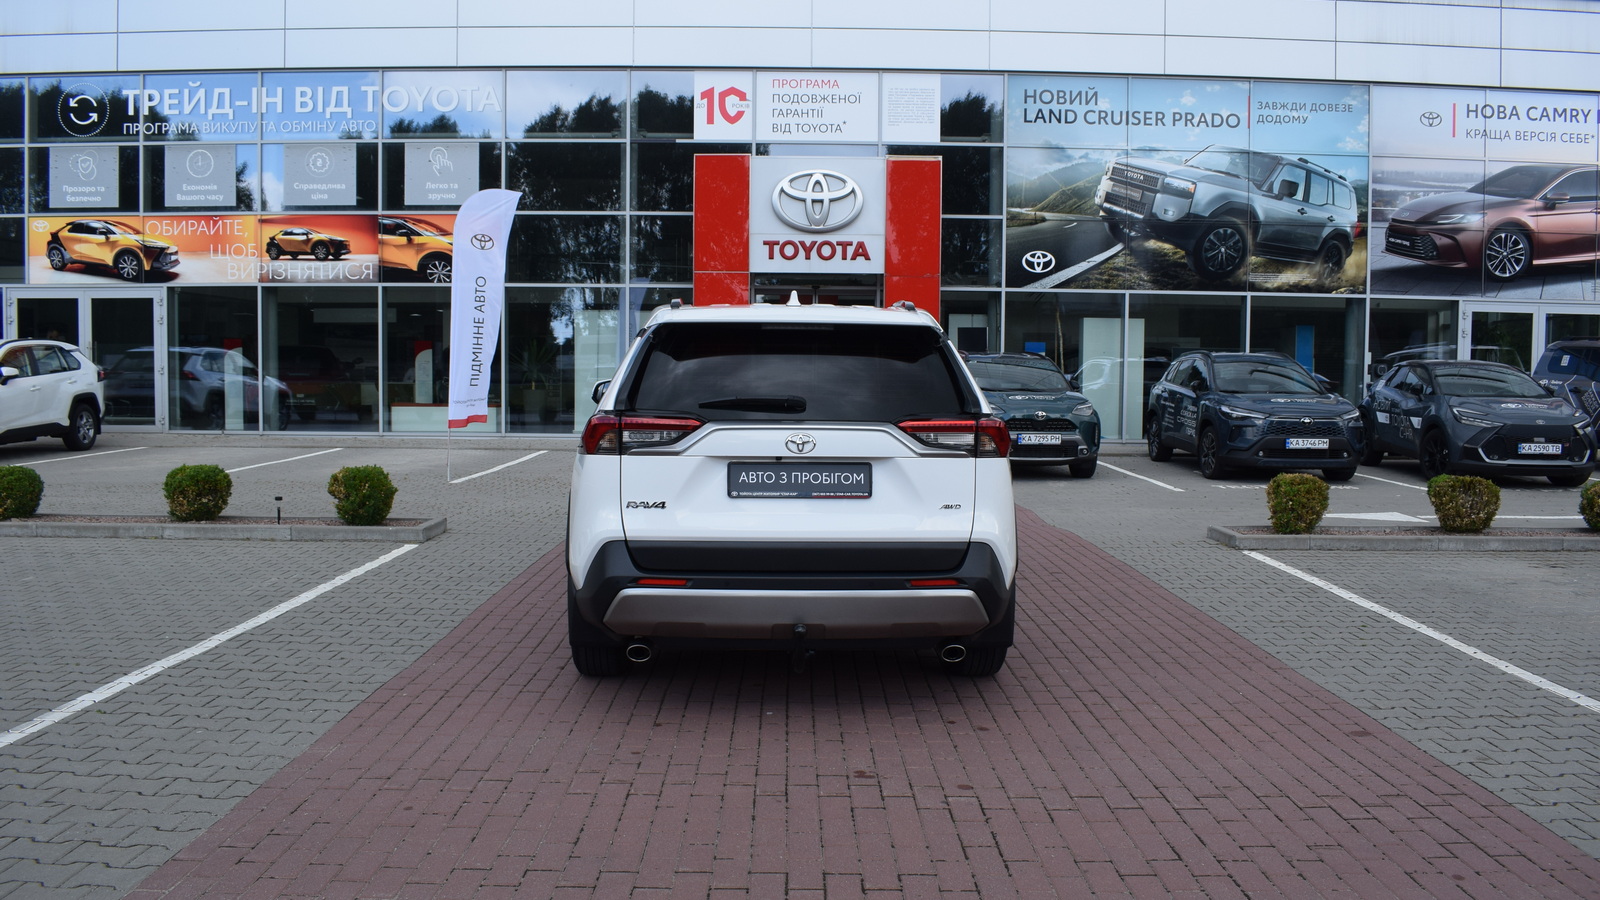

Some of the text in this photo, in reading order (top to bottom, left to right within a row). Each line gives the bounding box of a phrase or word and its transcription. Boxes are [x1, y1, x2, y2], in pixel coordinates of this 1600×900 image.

[772, 79, 840, 89] ПРОГРАМА
[122, 81, 502, 120] ТРЕЙД-ІН ВІД TOYOTA
[772, 92, 862, 106] ПОДОВЖЕНОЇ
[1023, 86, 1099, 106] НОВИЙ
[772, 107, 824, 118] ГАРАНТІЇ
[1256, 101, 1354, 114] ЗАВЖДИ ДОВЕЗЕ
[1466, 103, 1520, 120] НОВА
[1526, 106, 1592, 124] CAMRY
[1023, 107, 1241, 129] LAND CRUISER PRADO
[1256, 114, 1309, 126] ДОДОМУ
[123, 120, 377, 135] ПРОГРАМА ВИКУПУ ТА ОБМІНУ АВТО
[772, 123, 792, 135] ВІД
[1465, 129, 1511, 142] КРАЩА
[1515, 131, 1557, 143] ВЕРСІЯ
[63, 185, 96, 193] Прозоро
[293, 183, 346, 191] Справедлива
[311, 192, 328, 200] ціна
[145, 217, 249, 237] ОБИРАЙТЕ,
[210, 244, 258, 260] ЩОБ
[763, 240, 871, 261] TOYOTA
[227, 262, 373, 280] ВИРІЗНЯТИСЯ
[473, 276, 487, 313] АВТО
[470, 317, 485, 387] ПІДМІННЕ
[1021, 435, 1060, 443] KA 7295 PH
[1289, 439, 1328, 447] KA 3746 PM
[1521, 444, 1561, 453] KA 2590 TB
[738, 471, 776, 484] АВТО
[791, 472, 864, 485] ПРОБІГОМ
[626, 501, 667, 509] RAV4
